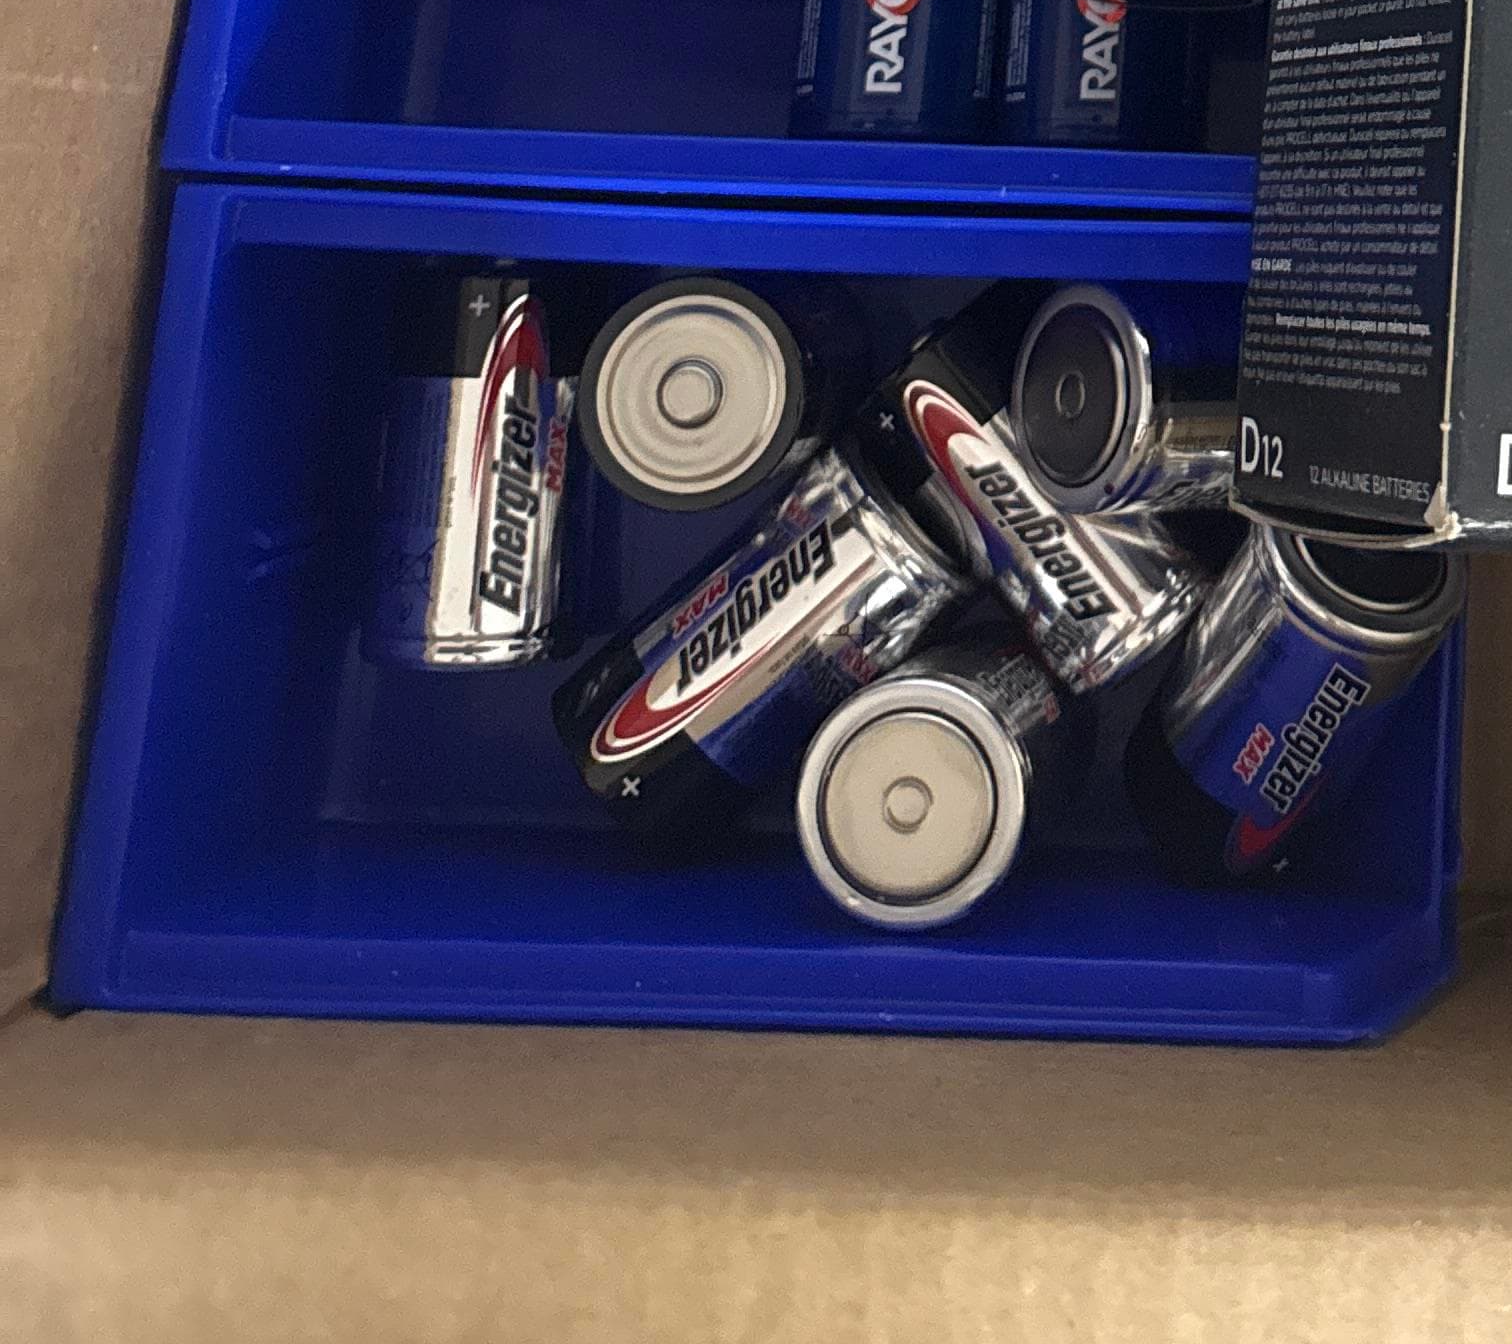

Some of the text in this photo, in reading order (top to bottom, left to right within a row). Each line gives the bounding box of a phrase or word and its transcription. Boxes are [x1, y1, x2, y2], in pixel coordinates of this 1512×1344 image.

[544, 422, 568, 494] MAX
[1240, 416, 1284, 479] D12
[479, 392, 541, 616] Energizer
[1308, 465, 1430, 503] 12 ALKALINE BATTERIES
[964, 459, 1116, 623] Energizer
[672, 571, 730, 640] MAX
[675, 518, 838, 697] Energizer
[1230, 722, 1276, 784] MAX
[1259, 662, 1373, 815] Energizer
